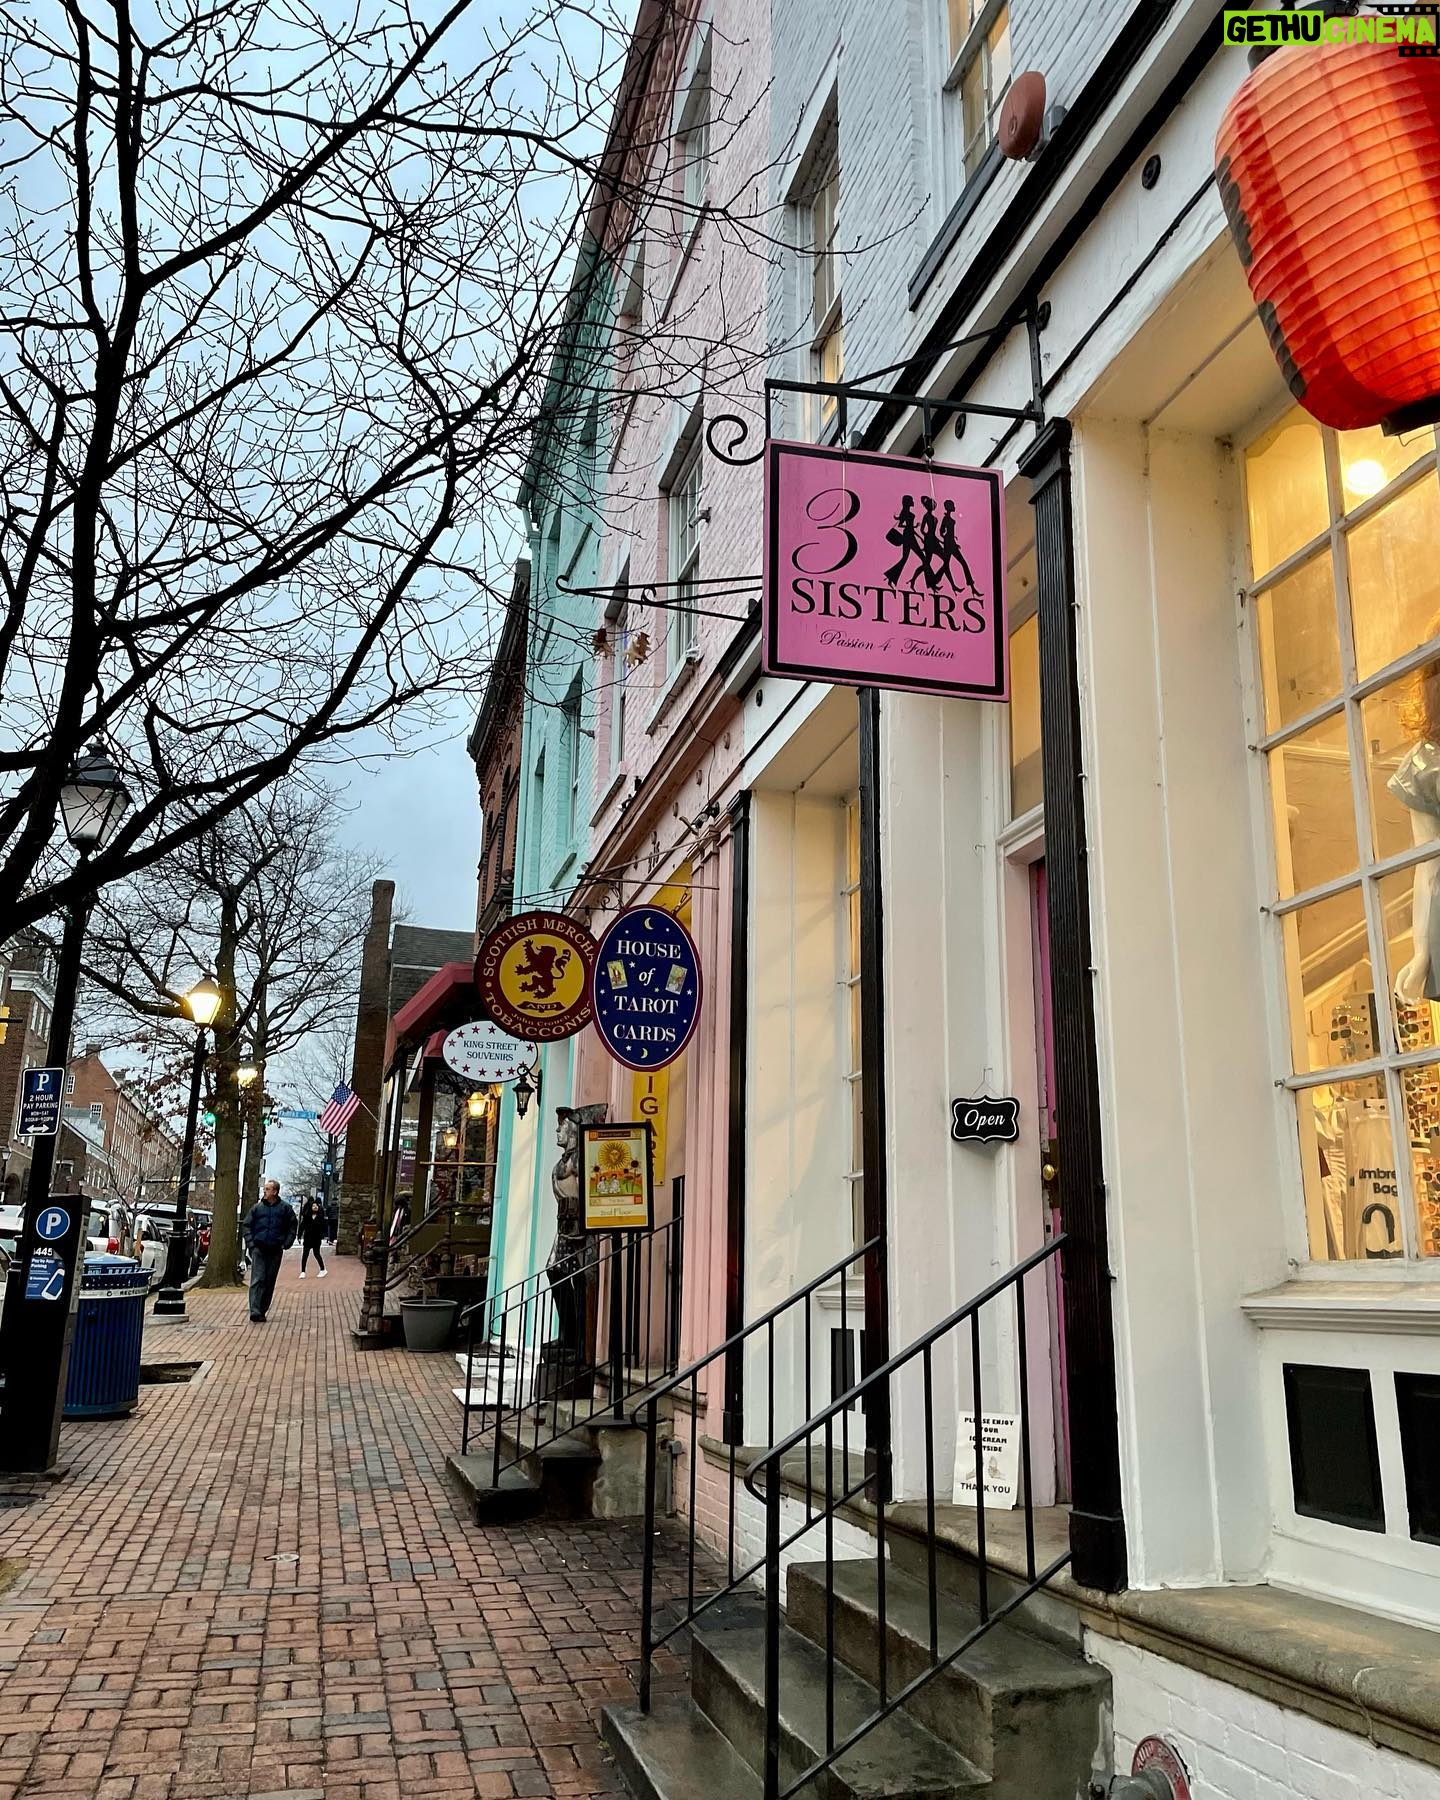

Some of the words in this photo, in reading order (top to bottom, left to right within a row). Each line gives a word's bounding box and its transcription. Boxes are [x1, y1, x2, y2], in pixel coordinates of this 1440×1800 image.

[791, 488, 861, 574] 3
[791, 577, 986, 634] SISTERS
[820, 629, 874, 650] Passion
[878, 637, 895, 652] 4
[900, 638, 955, 659] Fashion
[483, 918, 538, 977] SCOTTISH
[543, 918, 595, 966] MERCH
[617, 940, 681, 960] HOUSE
[639, 968, 656, 986] of
[486, 992, 592, 1037] TOBACCONIS
[614, 995, 679, 1015] TAROT
[613, 1023, 676, 1042] CARDS
[463, 1040, 484, 1049] KING
[485, 1042, 518, 1051] STREET
[466, 1051, 514, 1061] SOUVENIRS
[36, 1072, 50, 1092] P
[23, 1102, 35, 1110] PAY
[963, 1108, 1006, 1131] Open
[1358, 1167, 1397, 1180] Umbre
[45, 1213, 62, 1235] P
[964, 1417, 991, 1425] PLSE
[973, 1445, 1003, 1453] OTSIDE
[982, 1436, 1007, 1444] CREAM
[960, 1482, 990, 1493] THAK
[992, 1485, 1011, 1494] YOU
